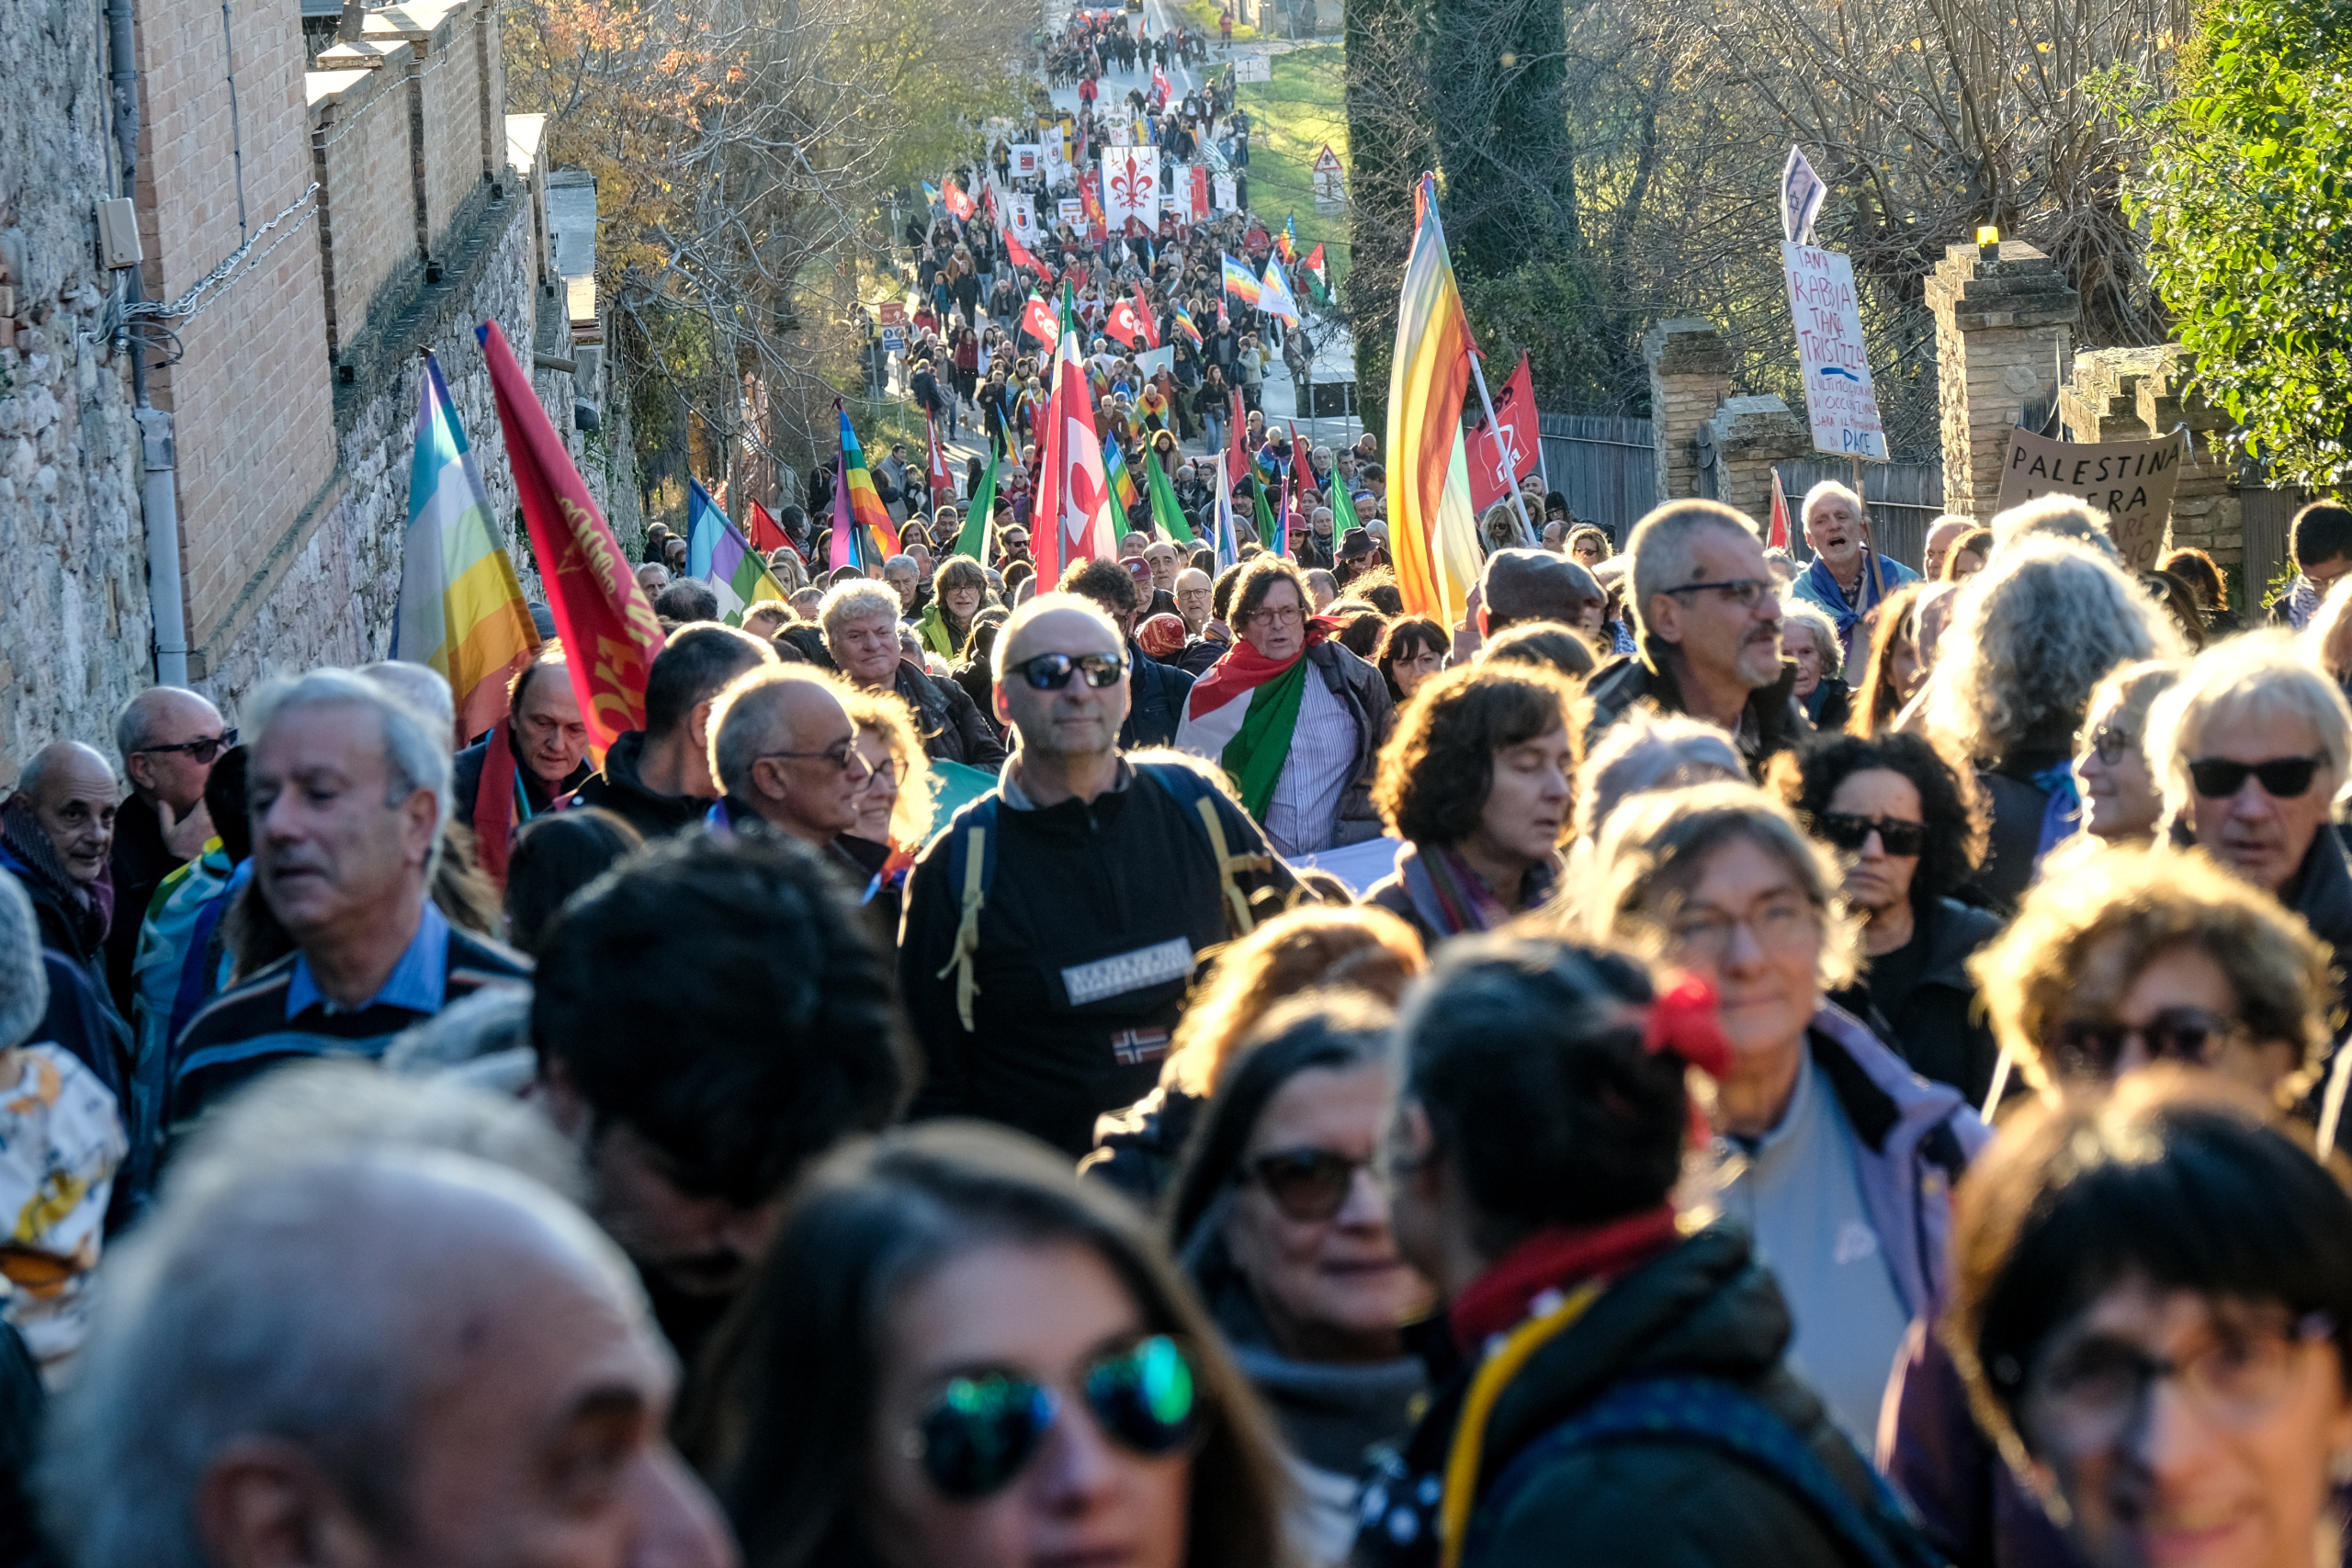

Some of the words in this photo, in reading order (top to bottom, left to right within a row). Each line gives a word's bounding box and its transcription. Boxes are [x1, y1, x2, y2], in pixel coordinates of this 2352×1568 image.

[1792, 270, 1853, 311] RABBIA
[1843, 428, 1875, 457] PACE
[2012, 442, 2179, 486] PALESTINA
